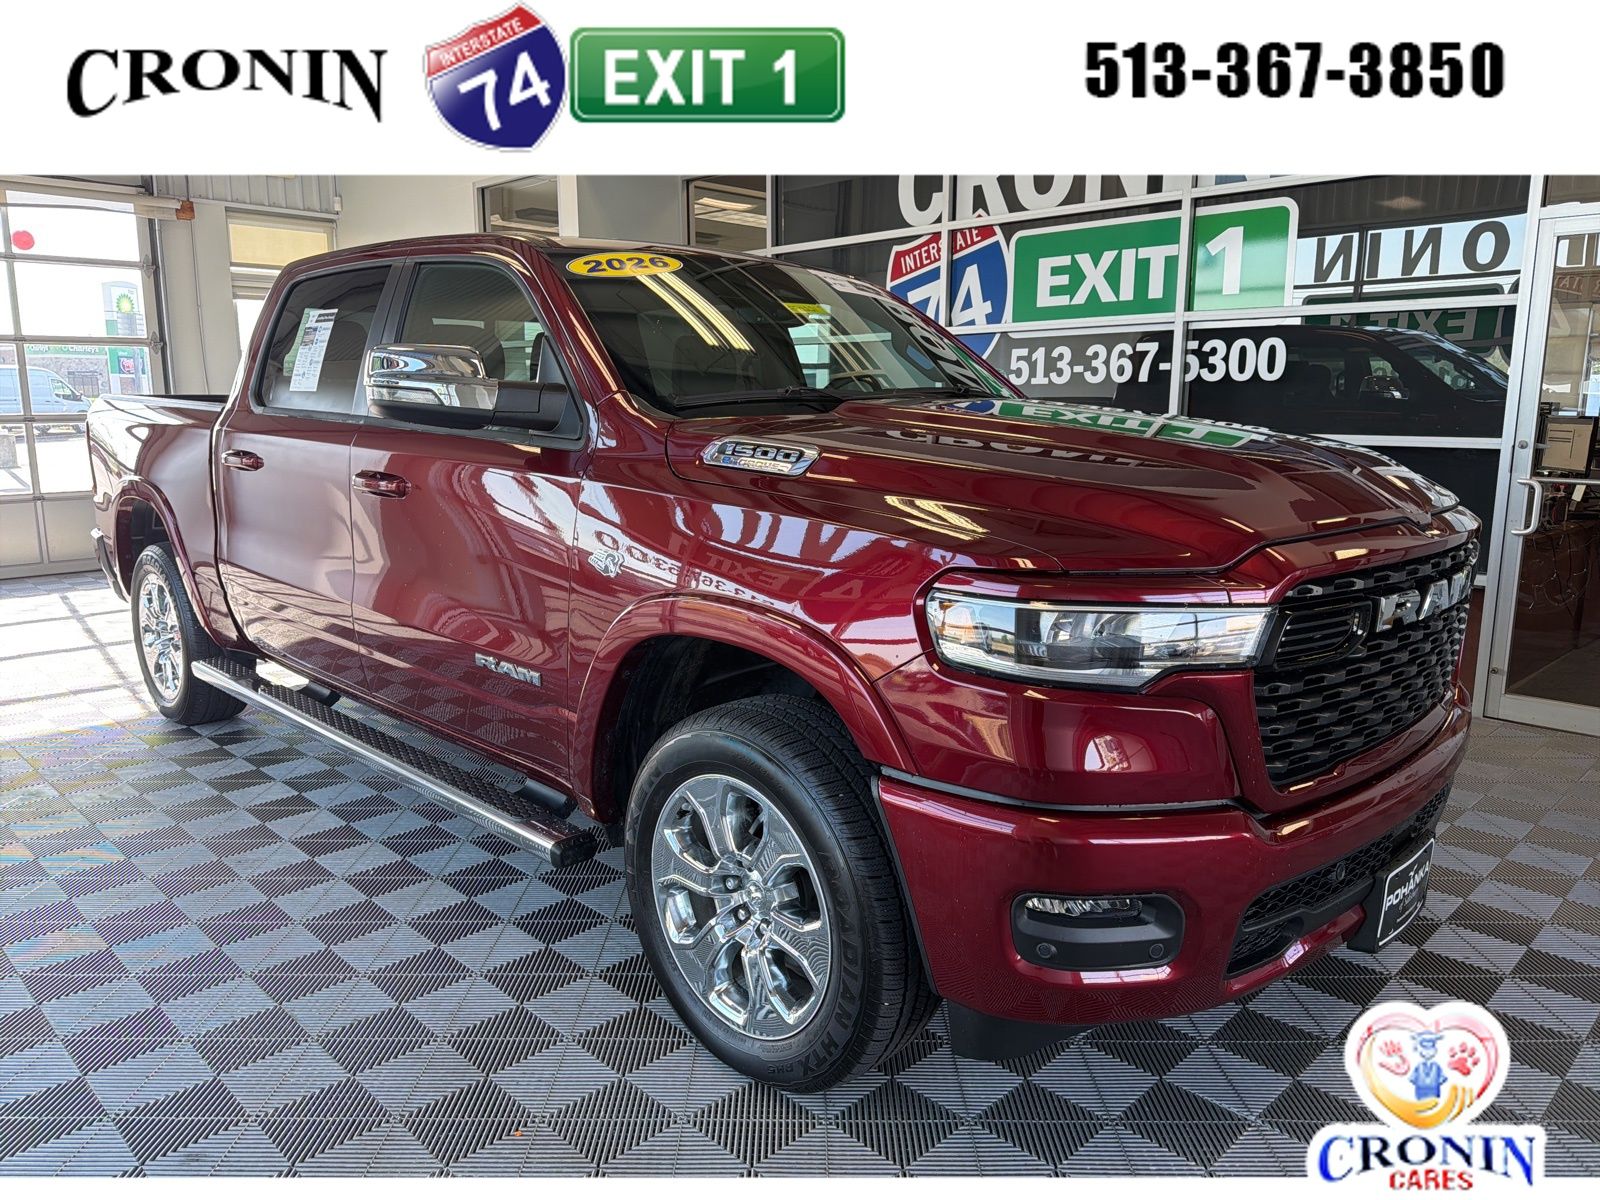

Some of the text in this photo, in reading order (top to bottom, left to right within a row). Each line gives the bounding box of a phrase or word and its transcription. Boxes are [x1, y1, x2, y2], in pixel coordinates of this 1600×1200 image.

[582, 256, 670, 274] 2026
[1036, 225, 1246, 308] EXIT 1
[906, 264, 993, 330] 74
[1008, 336, 1288, 386] 513-367-5300
[724, 442, 801, 463] 1500
[1376, 568, 1472, 633] RAM
[474, 652, 542, 688] RAM
